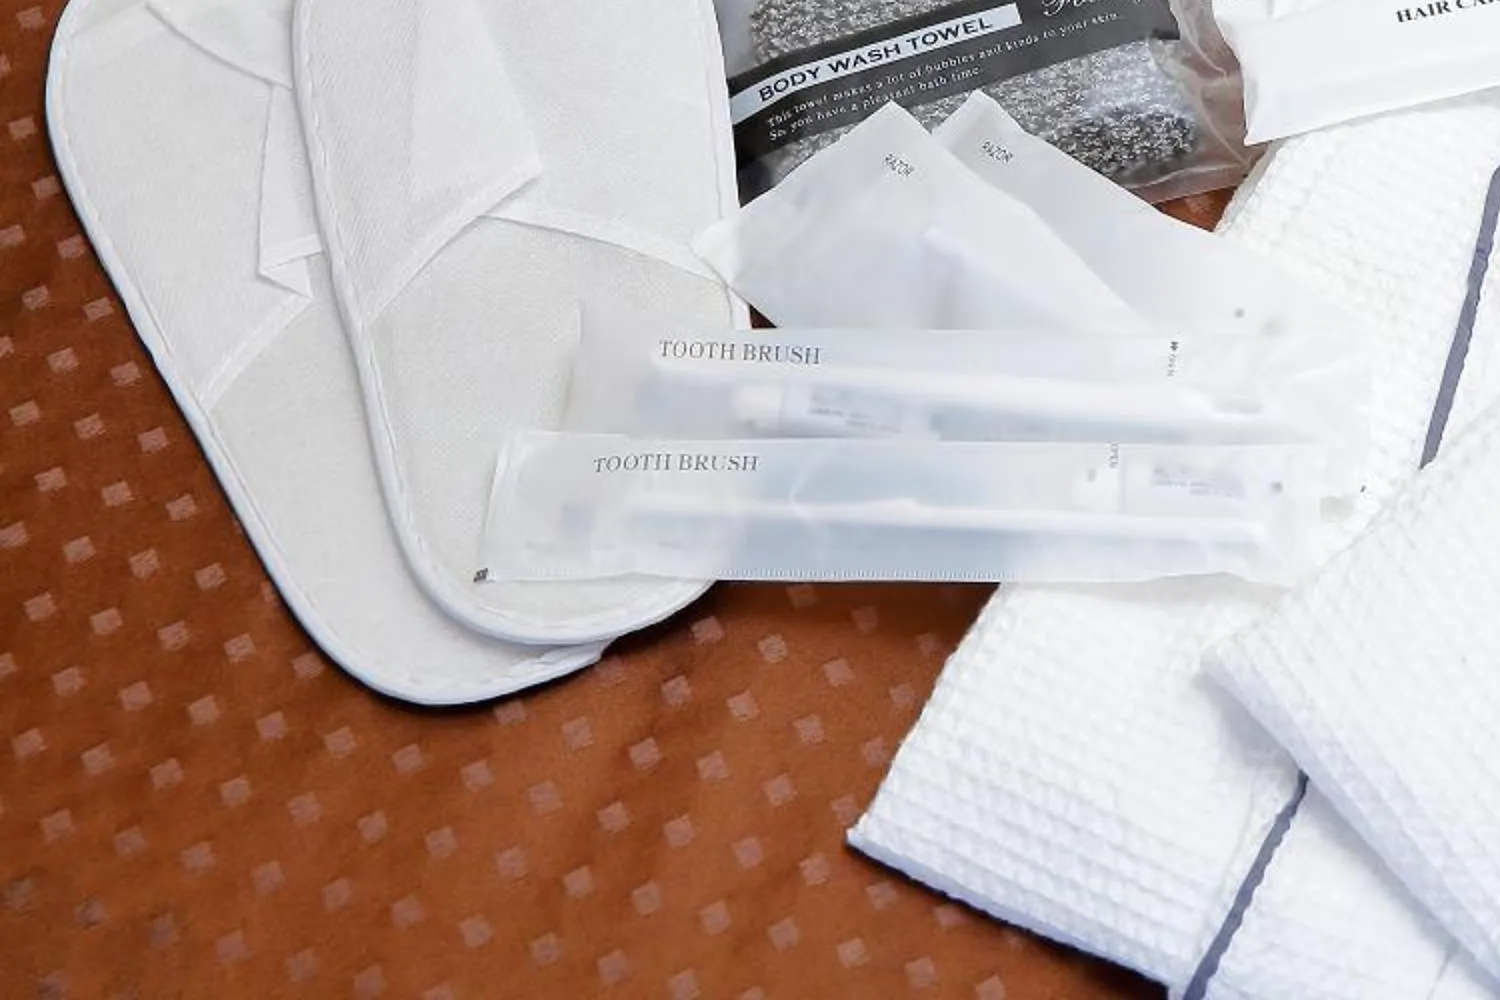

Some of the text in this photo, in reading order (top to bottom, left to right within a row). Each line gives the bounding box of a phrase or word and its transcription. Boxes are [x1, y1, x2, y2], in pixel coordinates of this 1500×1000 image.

[1396, 0, 1451, 23] HAIR
[758, 17, 993, 102] BODY WASH TOWEL
[925, 54, 975, 73] bubbles
[659, 340, 822, 364] TOOTH BRUSH
[594, 453, 760, 474] TOOTH BRUSH
